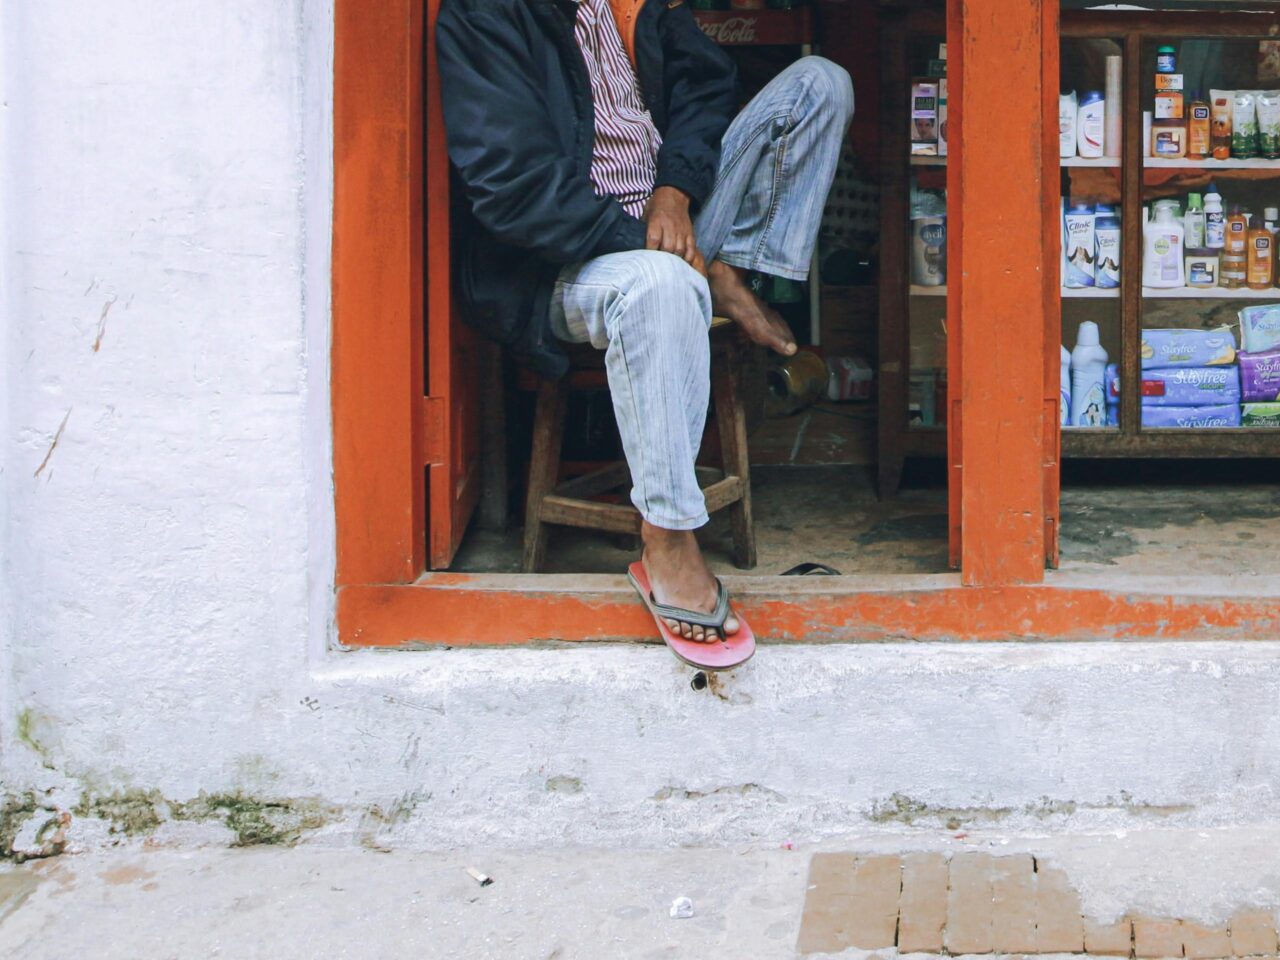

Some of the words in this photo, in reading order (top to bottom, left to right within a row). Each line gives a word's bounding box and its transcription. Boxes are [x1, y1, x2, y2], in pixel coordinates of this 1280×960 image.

[695, 15, 758, 43] oca-Cola
[1069, 221, 1091, 231] Clinic
[1161, 343, 1197, 354] Stayfree
[1173, 369, 1227, 387] Stayfree
